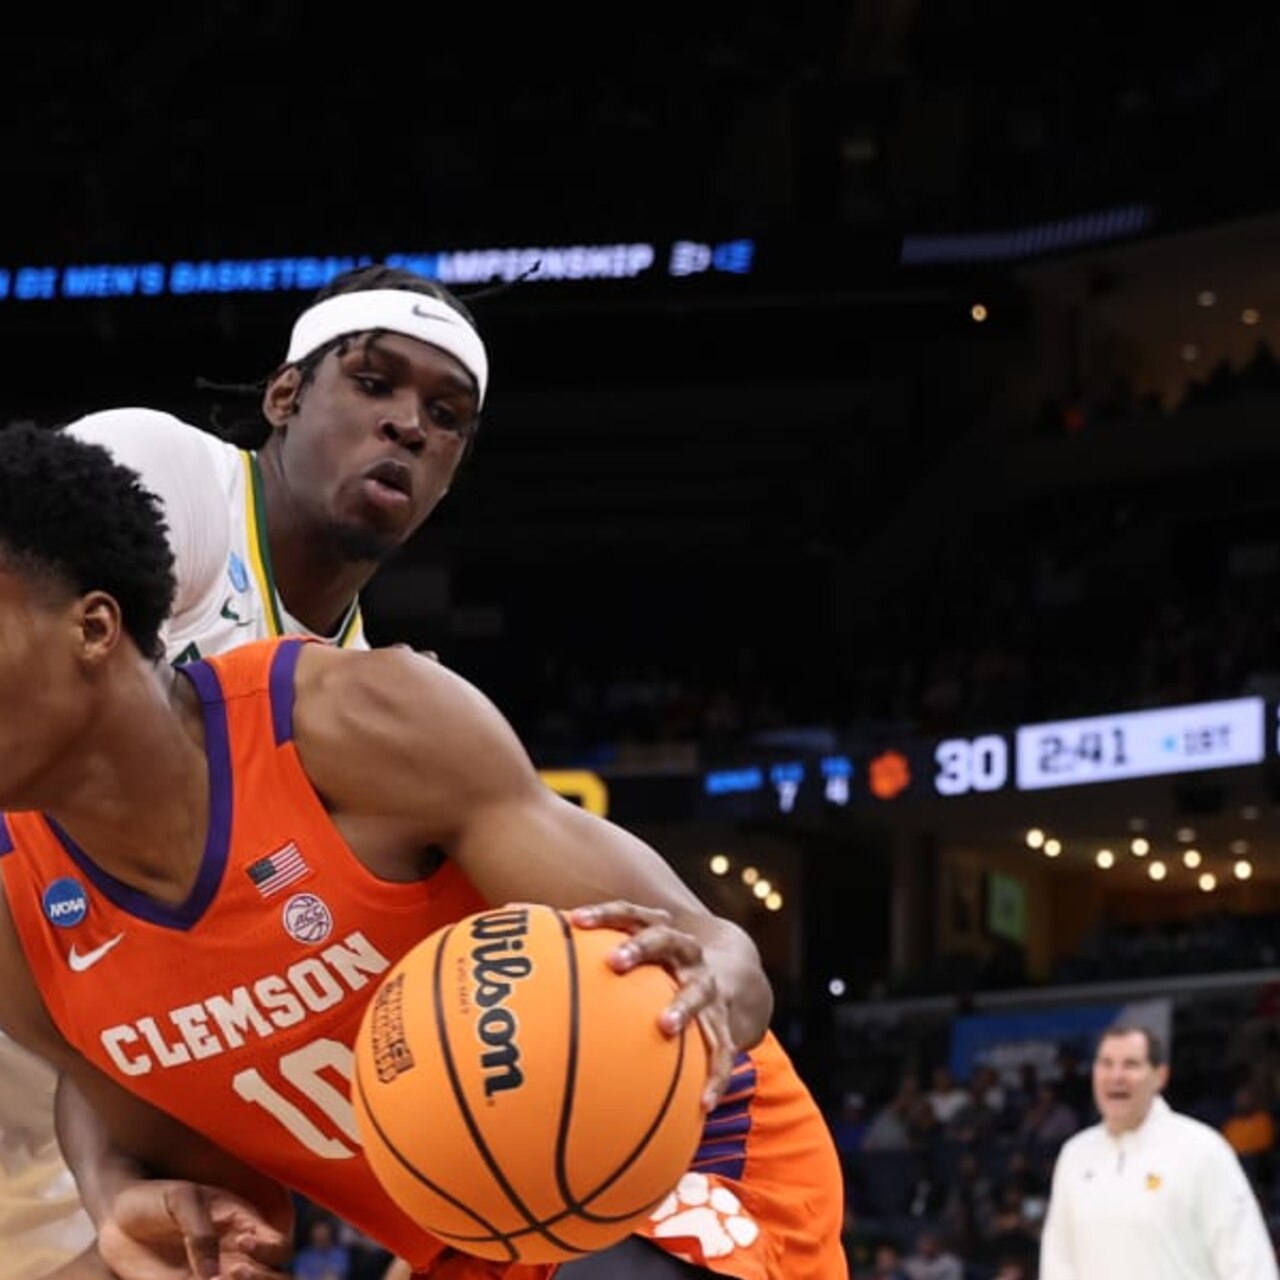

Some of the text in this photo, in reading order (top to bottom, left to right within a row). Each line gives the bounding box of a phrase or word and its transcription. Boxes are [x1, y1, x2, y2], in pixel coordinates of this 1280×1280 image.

[935, 735, 1007, 797] 30
[101, 931, 391, 1076] CLEMSON
[471, 909, 532, 1097] Wilson
[232, 1038, 364, 1160] 10
